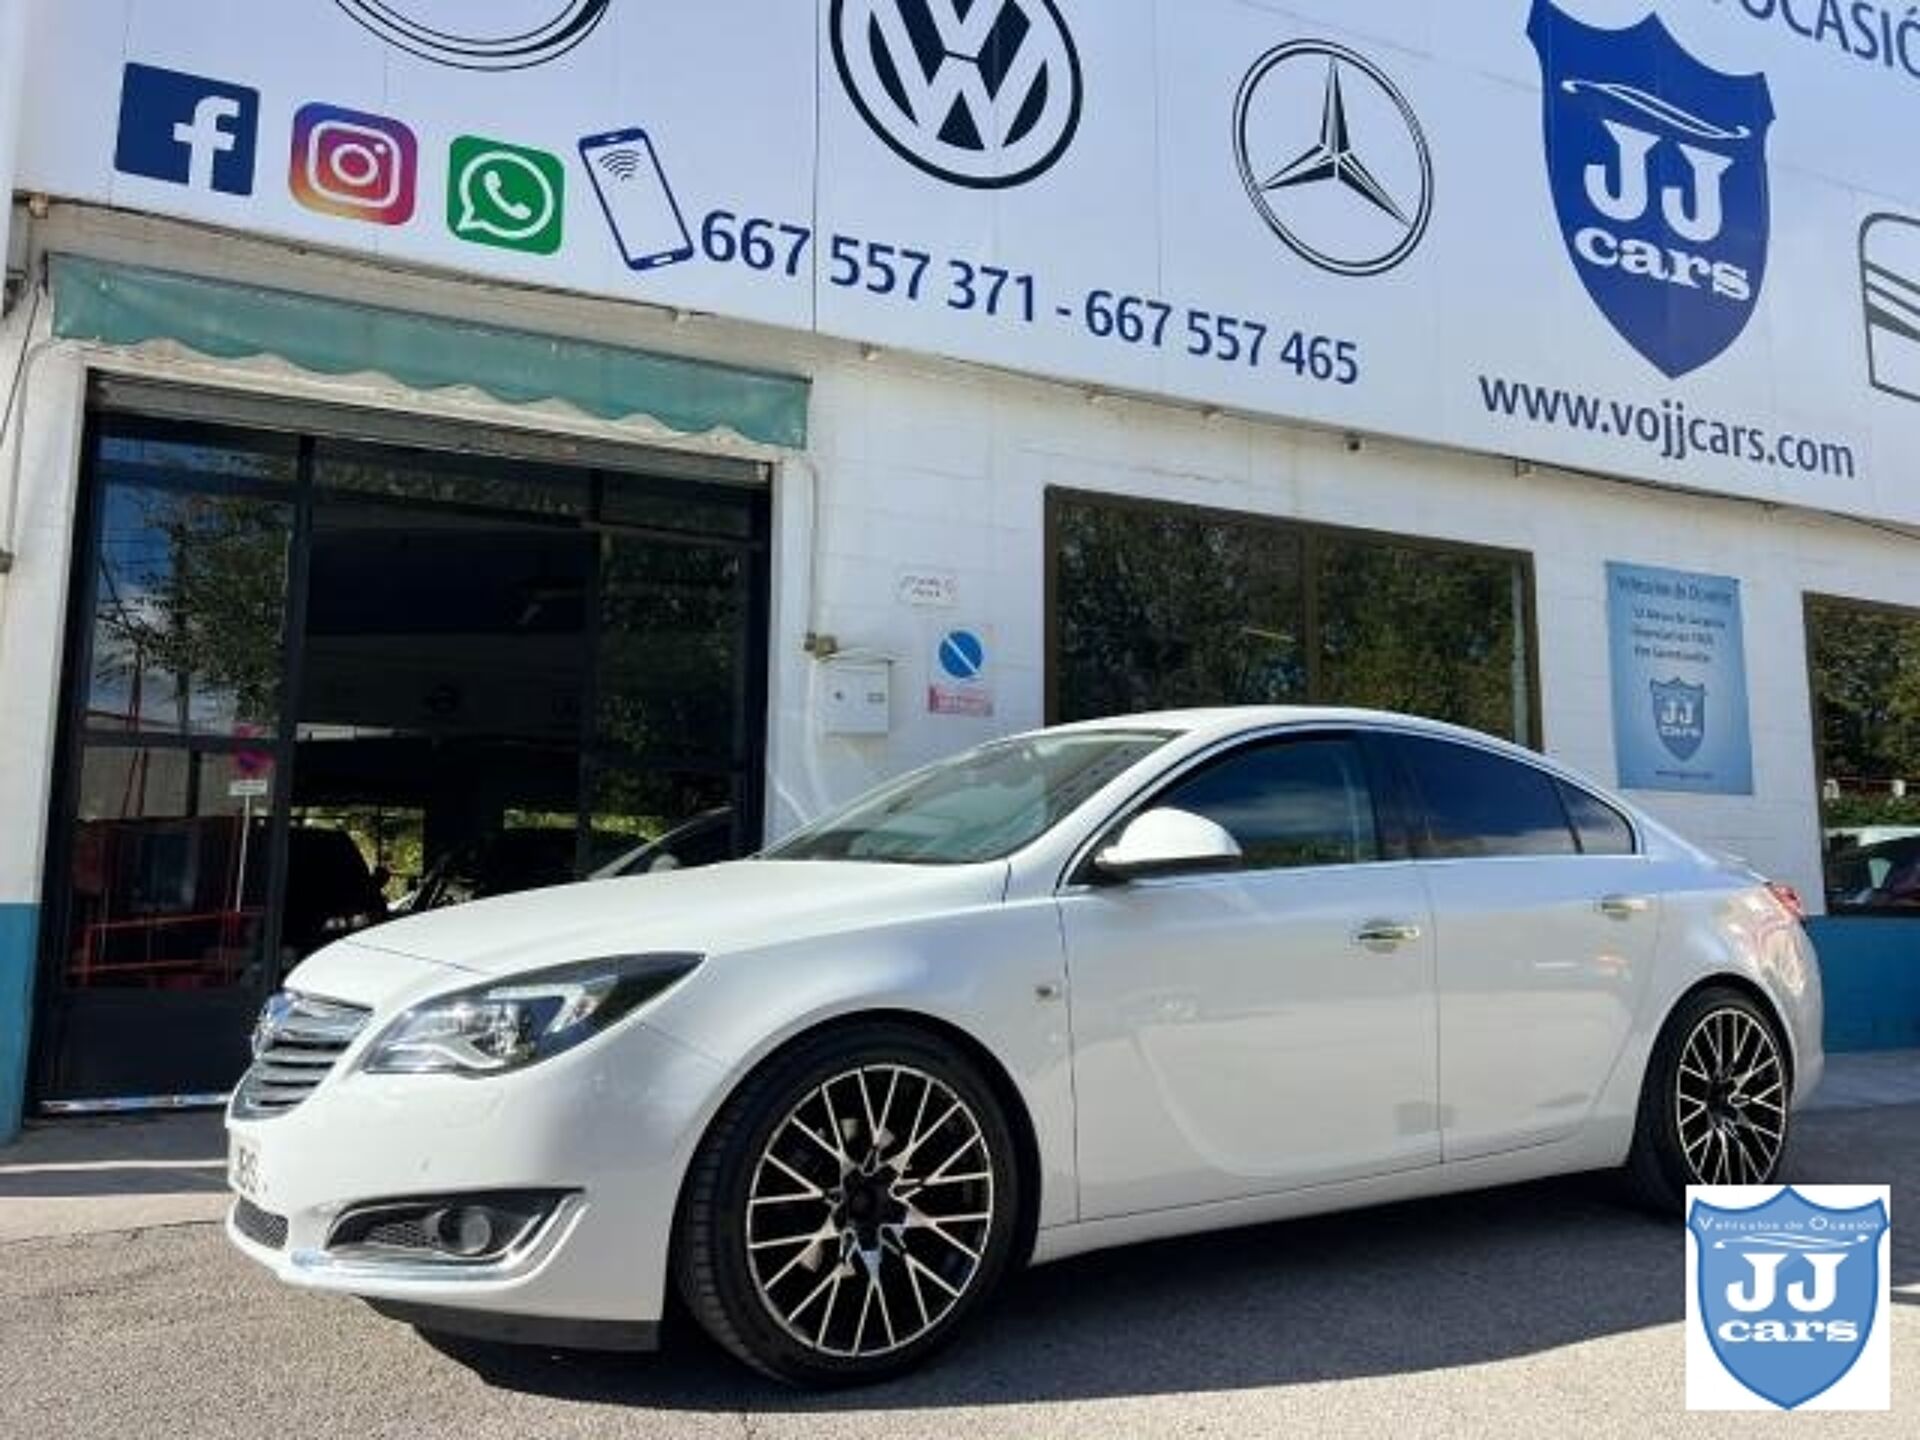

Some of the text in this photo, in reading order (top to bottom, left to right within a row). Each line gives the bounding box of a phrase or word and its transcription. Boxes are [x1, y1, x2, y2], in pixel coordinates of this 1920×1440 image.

[1584, 119, 1734, 242] JJ
[701, 209, 811, 276] 667
[830, 234, 931, 300] 557
[947, 259, 1034, 322] 371
[1085, 290, 1172, 347] 667
[1187, 310, 1267, 367] 557
[1280, 331, 1358, 385] 465
[1574, 226, 1751, 301] cars
[1478, 374, 1855, 479] www.vojjcars.com
[1661, 701, 1694, 724] JJ
